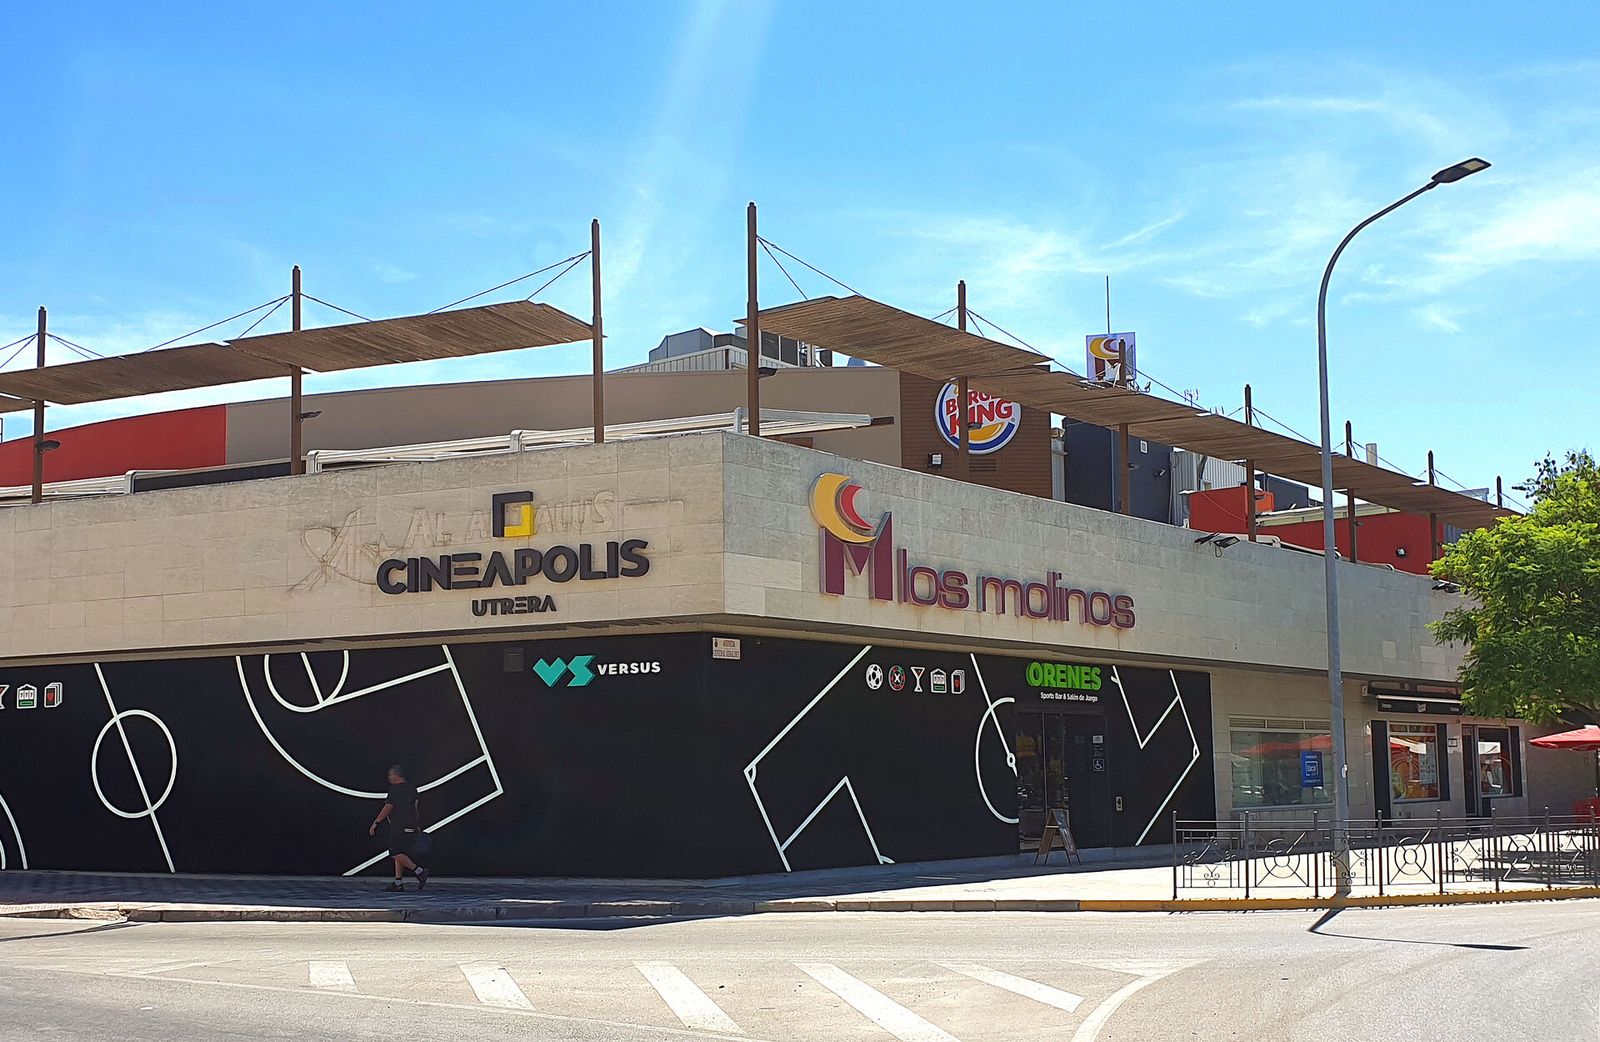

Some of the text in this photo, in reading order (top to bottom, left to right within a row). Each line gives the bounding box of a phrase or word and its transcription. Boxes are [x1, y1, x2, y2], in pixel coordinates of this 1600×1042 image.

[950, 400, 1012, 436] KING
[377, 539, 650, 595] CINEAPOLIS
[897, 548, 970, 609] los
[976, 571, 1136, 629] molinos
[471, 595, 557, 617] UTRERA
[597, 661, 661, 676] VERSUS
[1026, 661, 1101, 690] ORENES
[1055, 692, 1063, 700] Bar
